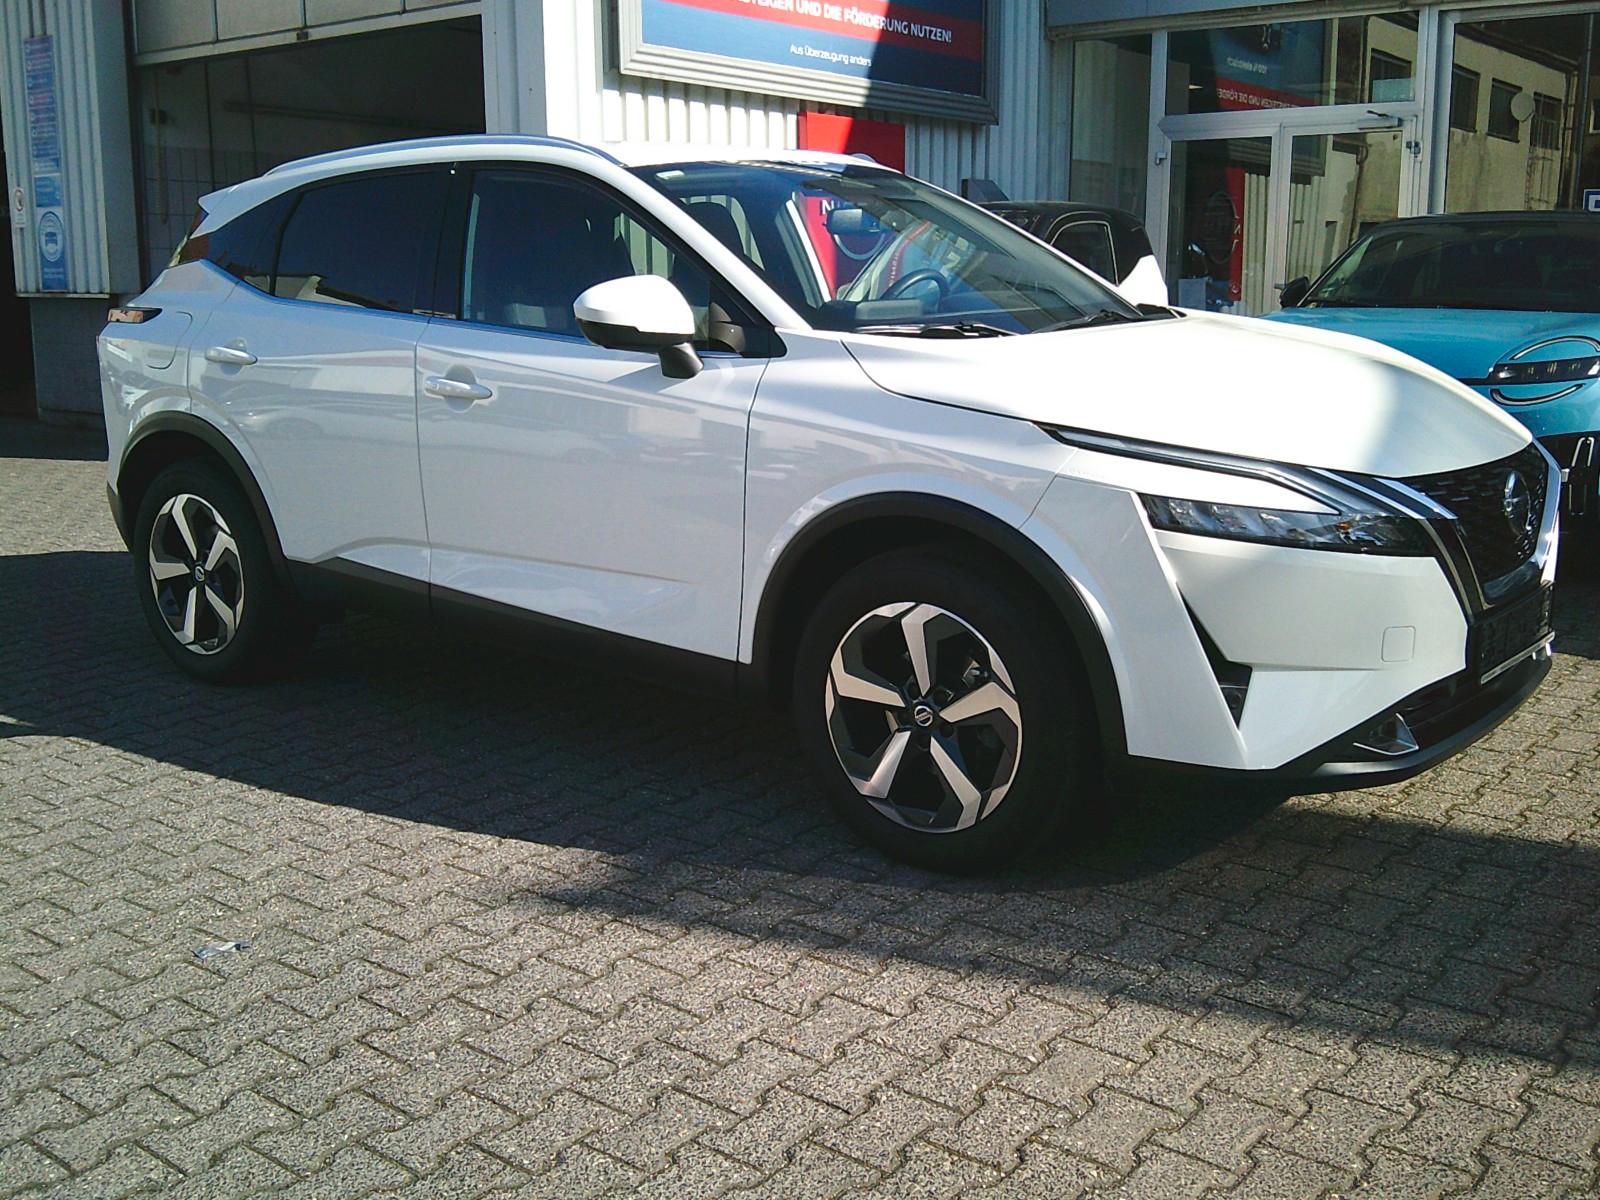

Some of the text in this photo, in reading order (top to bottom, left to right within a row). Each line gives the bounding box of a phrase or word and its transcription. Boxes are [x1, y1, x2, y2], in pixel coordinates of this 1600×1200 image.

[795, 0, 822, 17] UND
[823, 3, 843, 22] DIE
[843, 6, 909, 35] FÖRDERUNG
[910, 22, 952, 42] NUTZEN!
[790, 43, 872, 67] Aus Überzeugung anders
